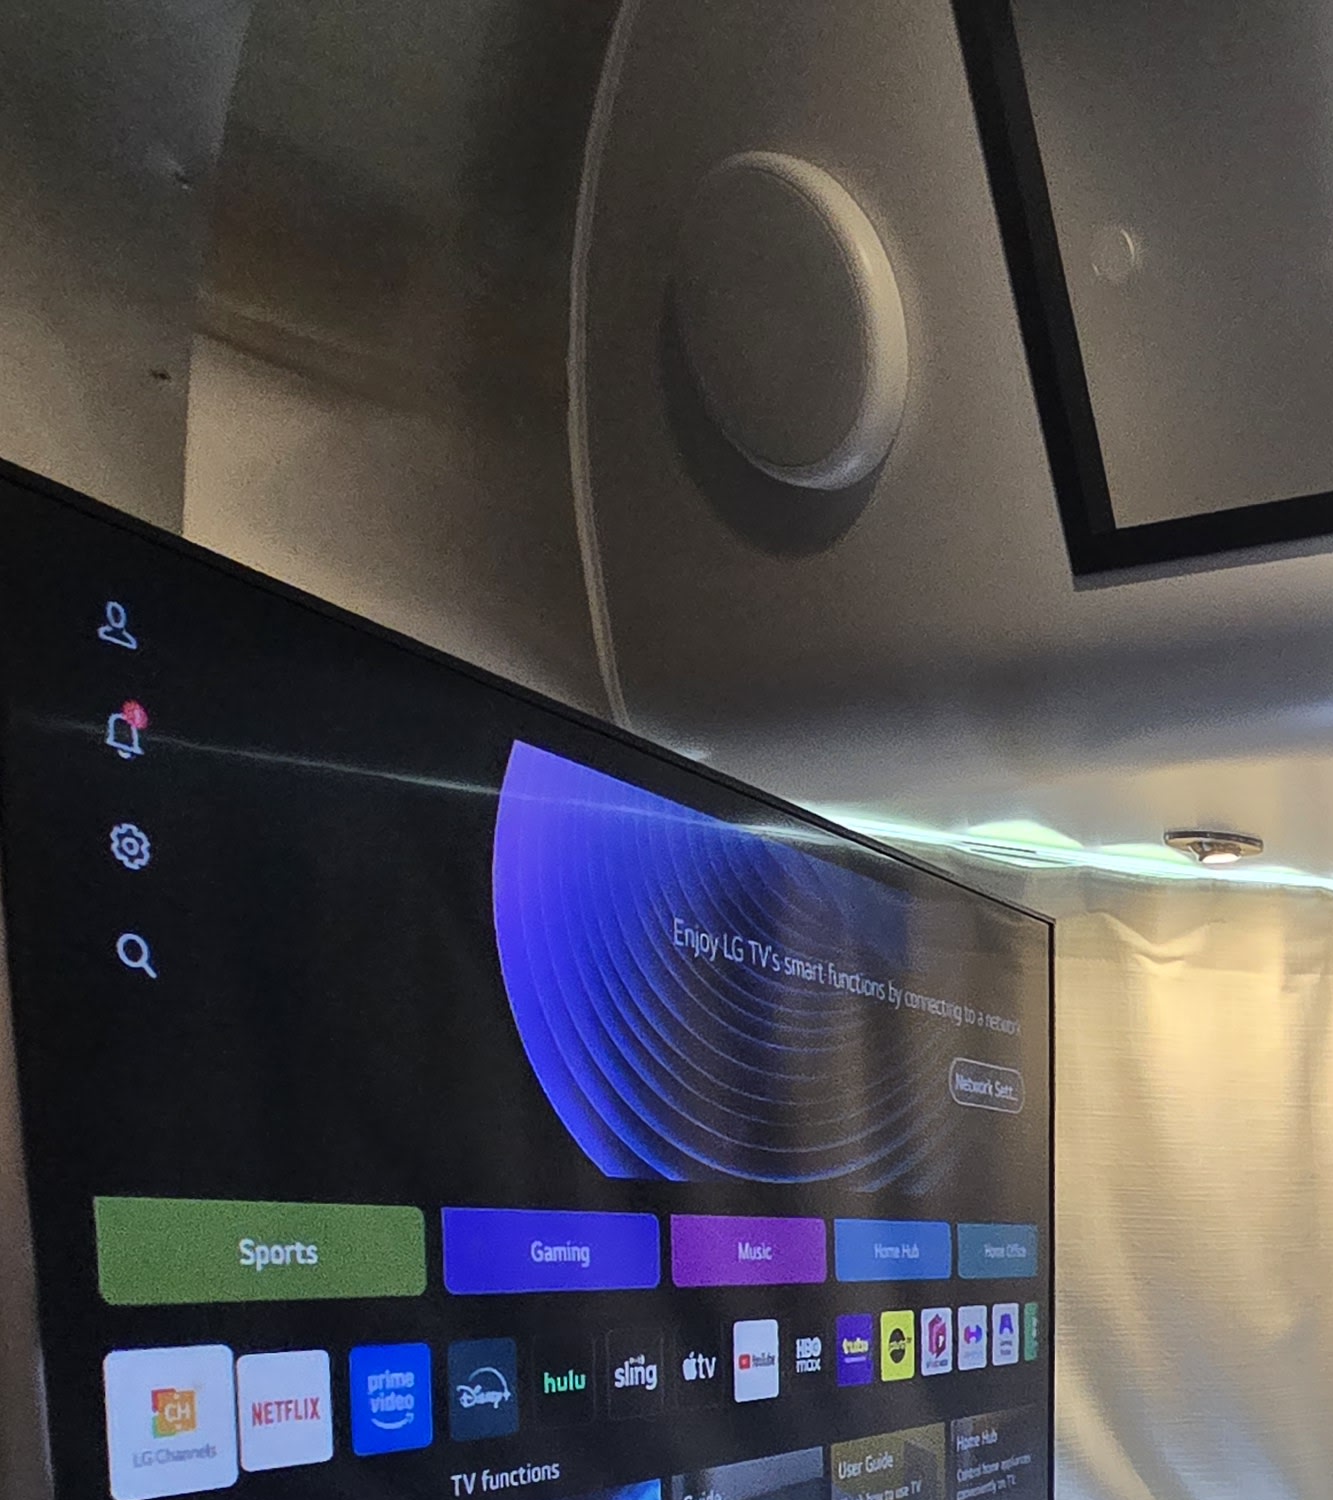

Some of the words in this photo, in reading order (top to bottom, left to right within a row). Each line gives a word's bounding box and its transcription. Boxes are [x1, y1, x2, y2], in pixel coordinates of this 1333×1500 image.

[673, 917, 719, 962] Enjoy
[723, 933, 744, 963] LG
[748, 940, 781, 972] TV's
[784, 956, 825, 984] smart
[828, 963, 886, 1001] functions
[888, 980, 901, 1009] by
[964, 1006, 976, 1025] to
[977, 1012, 984, 1027] a
[239, 1238, 319, 1271] Sports
[530, 1240, 591, 1268] Gaming
[738, 1242, 772, 1261] Music
[874, 1243, 900, 1259] Home
[901, 1243, 919, 1259] Hub
[795, 1336, 822, 1358] HBO
[367, 1369, 415, 1395] prime
[543, 1369, 586, 1393] hulu
[614, 1358, 658, 1390] sling
[164, 1401, 191, 1421] CH
[251, 1397, 321, 1427] NETFLIX
[370, 1392, 415, 1413] video
[133, 1449, 153, 1468] LG
[155, 1443, 218, 1464] Channels
[838, 1460, 863, 1480] User
[865, 1452, 894, 1472] Guide
[450, 1472, 476, 1497] TV
[481, 1462, 560, 1491] functions
